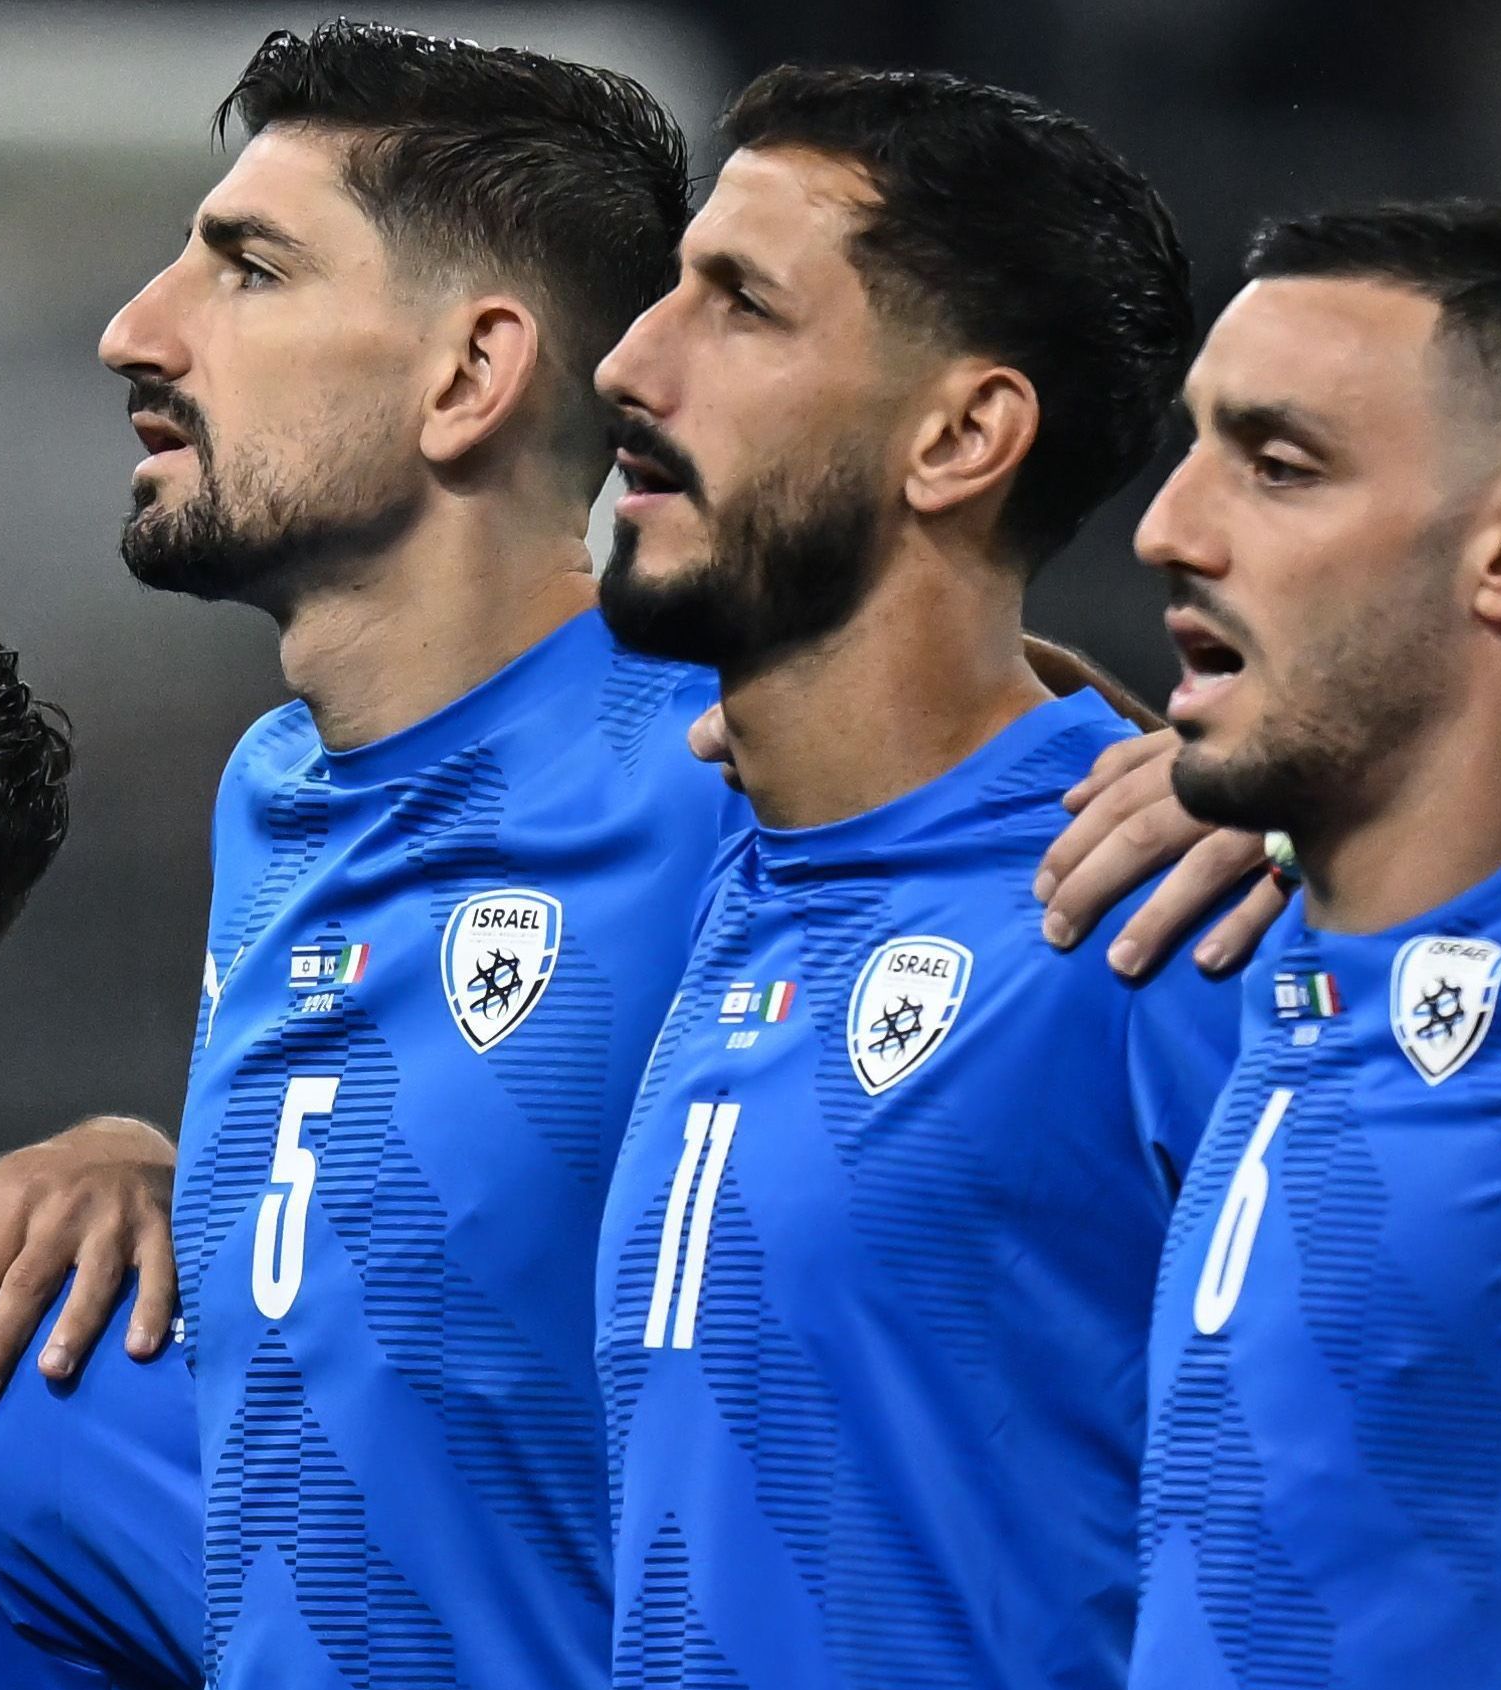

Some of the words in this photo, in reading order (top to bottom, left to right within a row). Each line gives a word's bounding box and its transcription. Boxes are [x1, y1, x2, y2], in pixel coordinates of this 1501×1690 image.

[471, 907, 540, 930] ISRAEL
[887, 952, 951, 979] ISRAEL
[251, 1076, 342, 1321] 5
[642, 1101, 742, 1351] 11
[1193, 1087, 1295, 1336] 6
